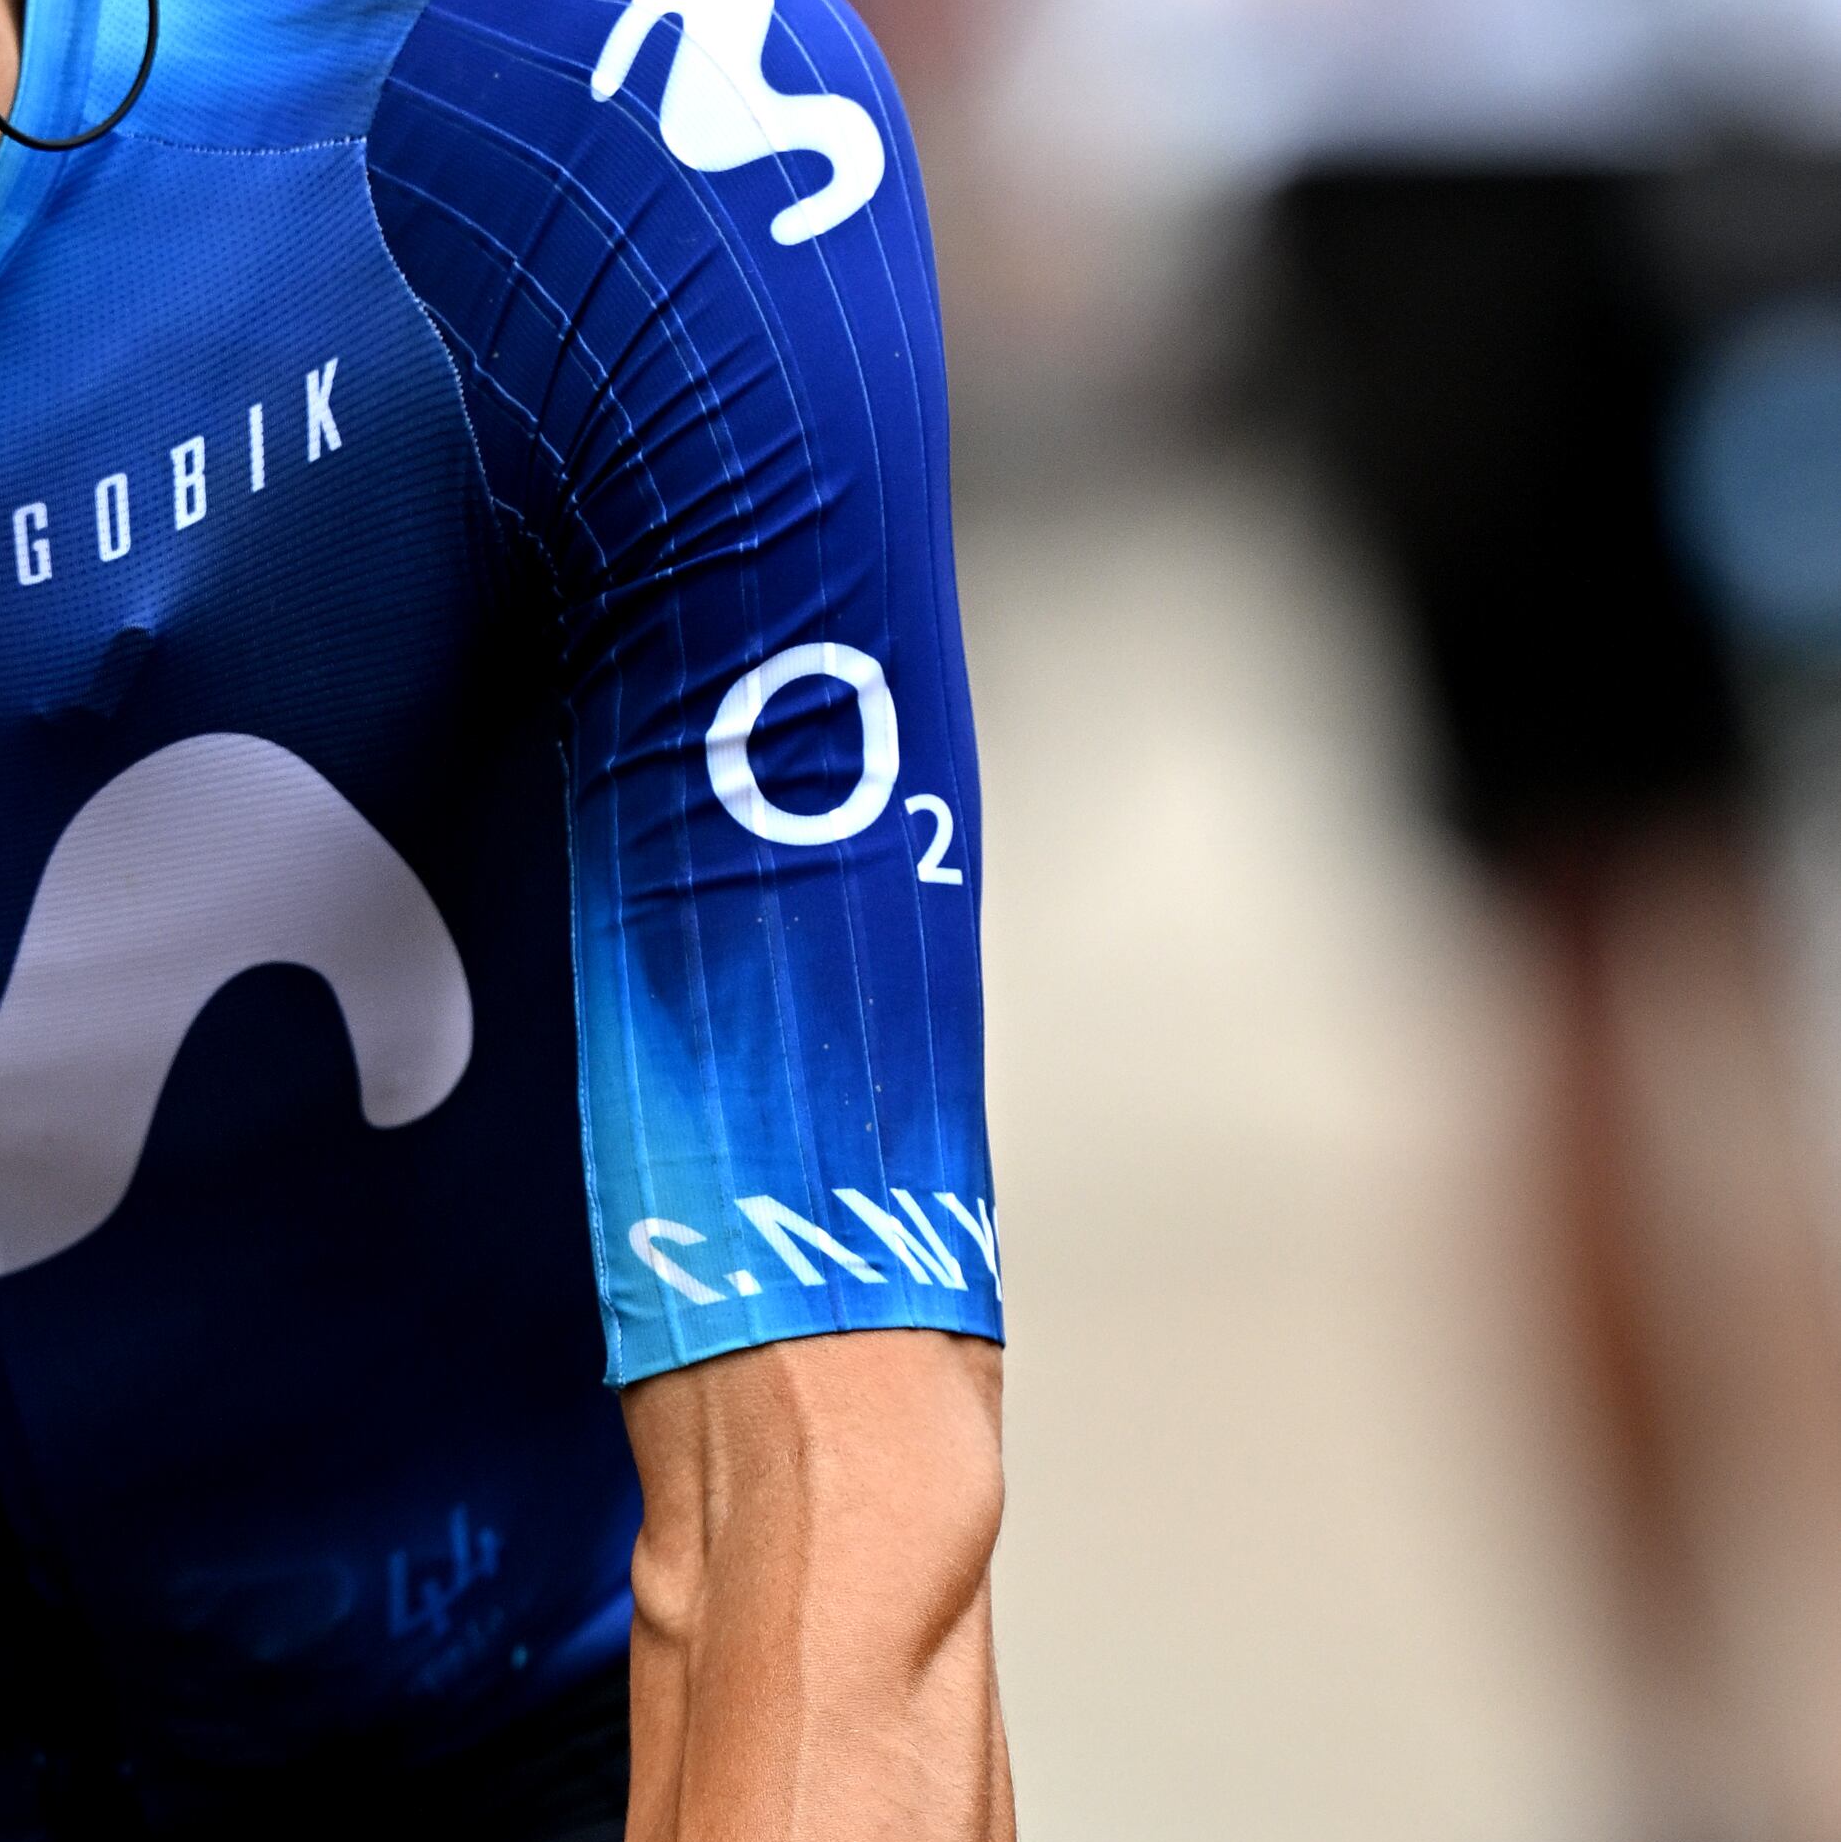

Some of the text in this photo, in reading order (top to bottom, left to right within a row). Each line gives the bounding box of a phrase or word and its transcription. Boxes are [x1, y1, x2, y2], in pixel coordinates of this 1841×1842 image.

[12, 357, 343, 587] GOBIK
[705, 641, 965, 886] O2
[629, 1188, 1004, 1306] CANY
